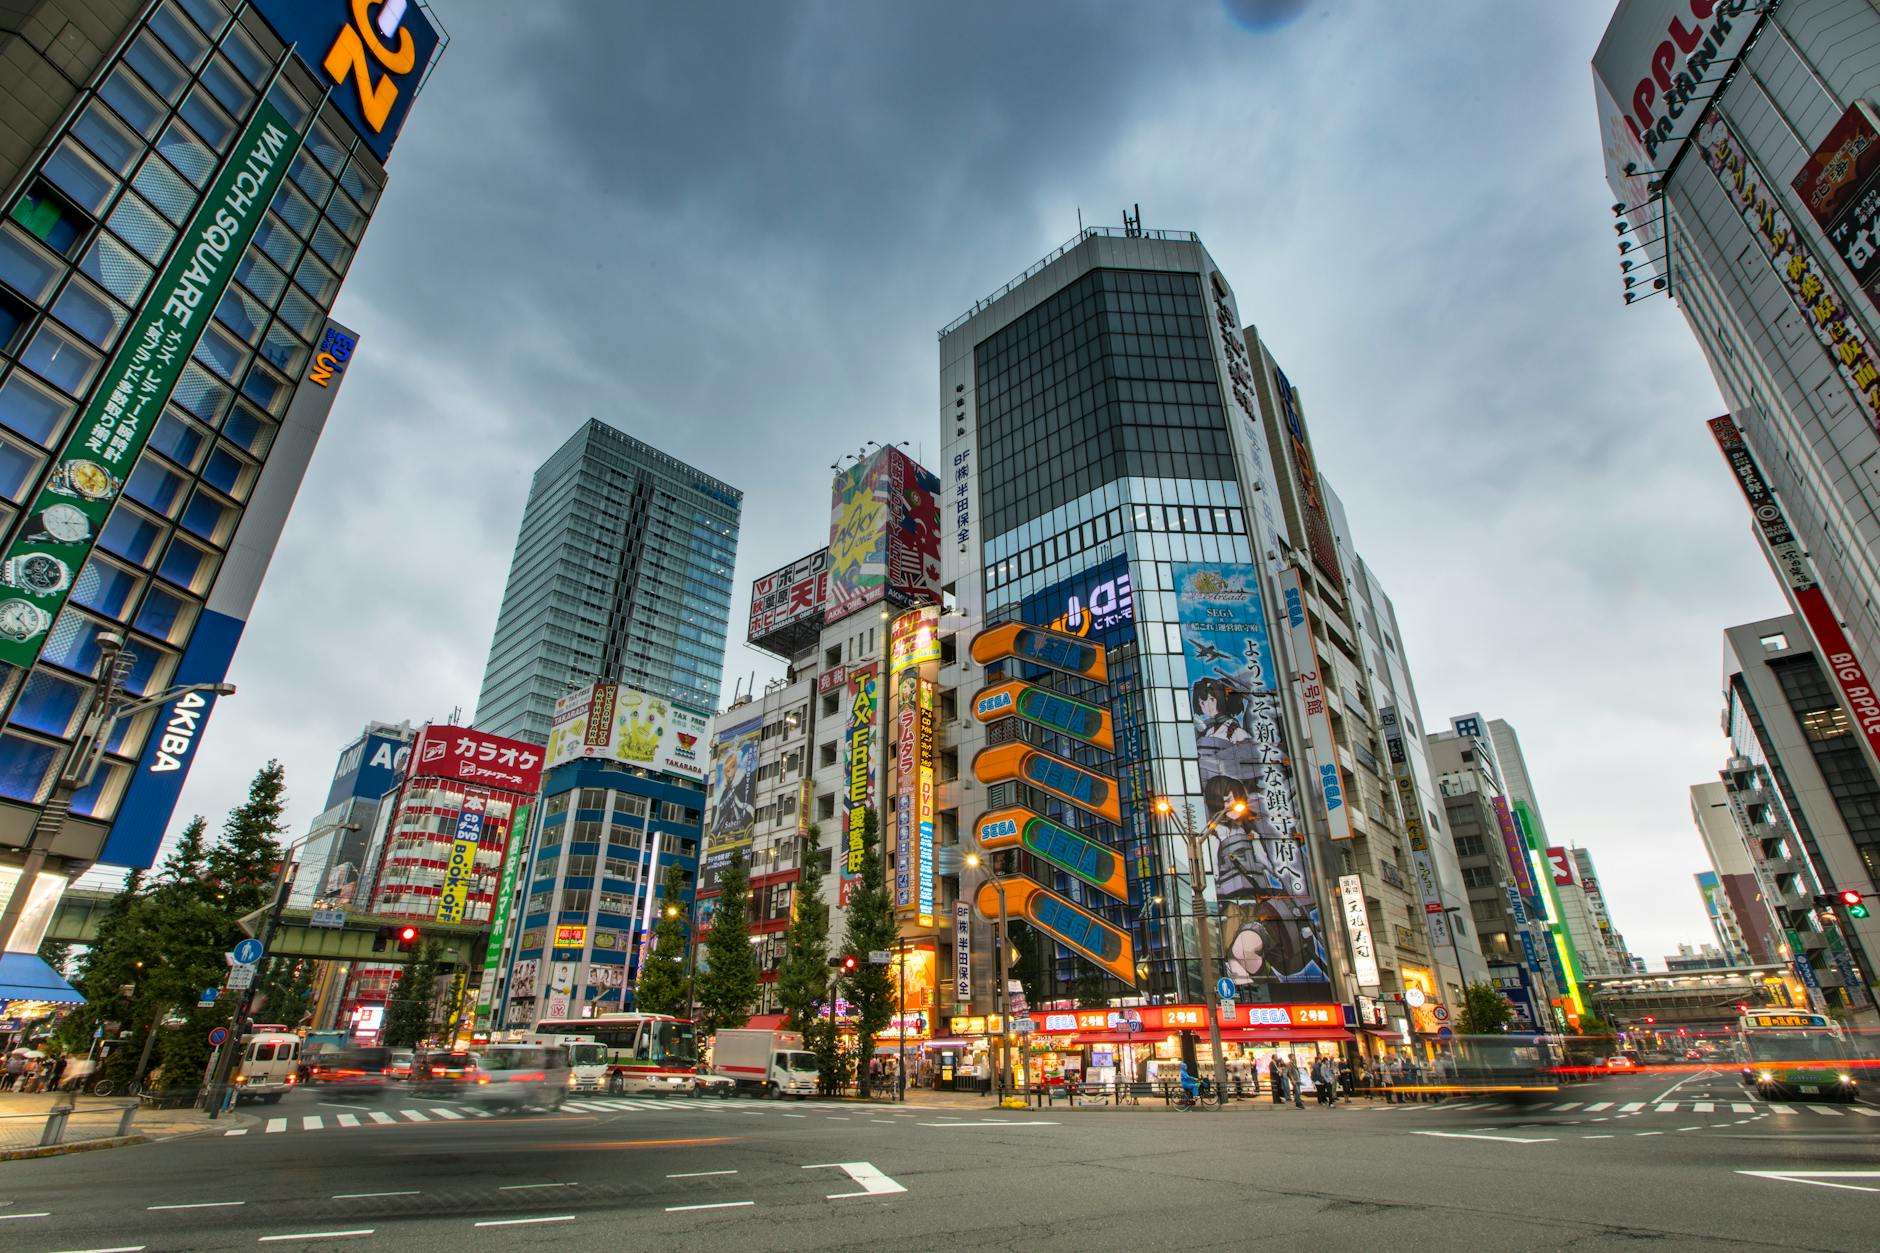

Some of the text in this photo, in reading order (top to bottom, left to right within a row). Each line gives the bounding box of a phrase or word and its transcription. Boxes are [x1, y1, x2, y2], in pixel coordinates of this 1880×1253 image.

[162, 121, 289, 328] WATCH SQUARE
[1832, 222, 1849, 243] 7F
[308, 330, 356, 390] EDION
[84, 319, 165, 454] 人気ブランド多数取り揃え
[102, 329, 182, 465] メンズ・レディース腕時計
[750, 609, 787, 632] ホビー
[1206, 607, 1234, 618] SEGA
[1284, 587, 1305, 629] SEGA
[820, 669, 845, 688] 免税
[1299, 671, 1324, 716] 2号館
[1830, 652, 1880, 735] BIG APPLE
[587, 688, 605, 745] AKIHABARA
[597, 685, 616, 745] WELCOME TO
[672, 711, 688, 721] TAX
[853, 672, 871, 728] TAX
[977, 691, 1013, 716] SEGA
[1027, 694, 1087, 733] SEGA
[150, 692, 206, 773] AKIBA
[900, 711, 915, 774] ラムタラ
[454, 737, 540, 770] カラオケ
[665, 758, 702, 774] TAKARADA
[850, 726, 871, 803] FREE
[476, 767, 524, 785] アドアーズ
[1033, 757, 1092, 804] SEGA
[1319, 763, 1343, 811] SEGA
[463, 796, 485, 811] 本
[922, 782, 932, 817] DVD
[457, 830, 478, 841] DVD
[459, 820, 480, 833] ゲーム
[463, 813, 479, 823] CD
[981, 819, 1018, 842] SEGA
[1034, 825, 1097, 876] SEGA
[1507, 888, 1527, 925] ALINCO
[1039, 903, 1104, 957] SEGA
[1046, 1015, 1078, 1031] SEGA
[1081, 1016, 1105, 1027] 2号館
[1168, 1011, 1198, 1025] 2号館
[1250, 1008, 1291, 1025] SEGA
[1300, 1009, 1329, 1023] 2号館
